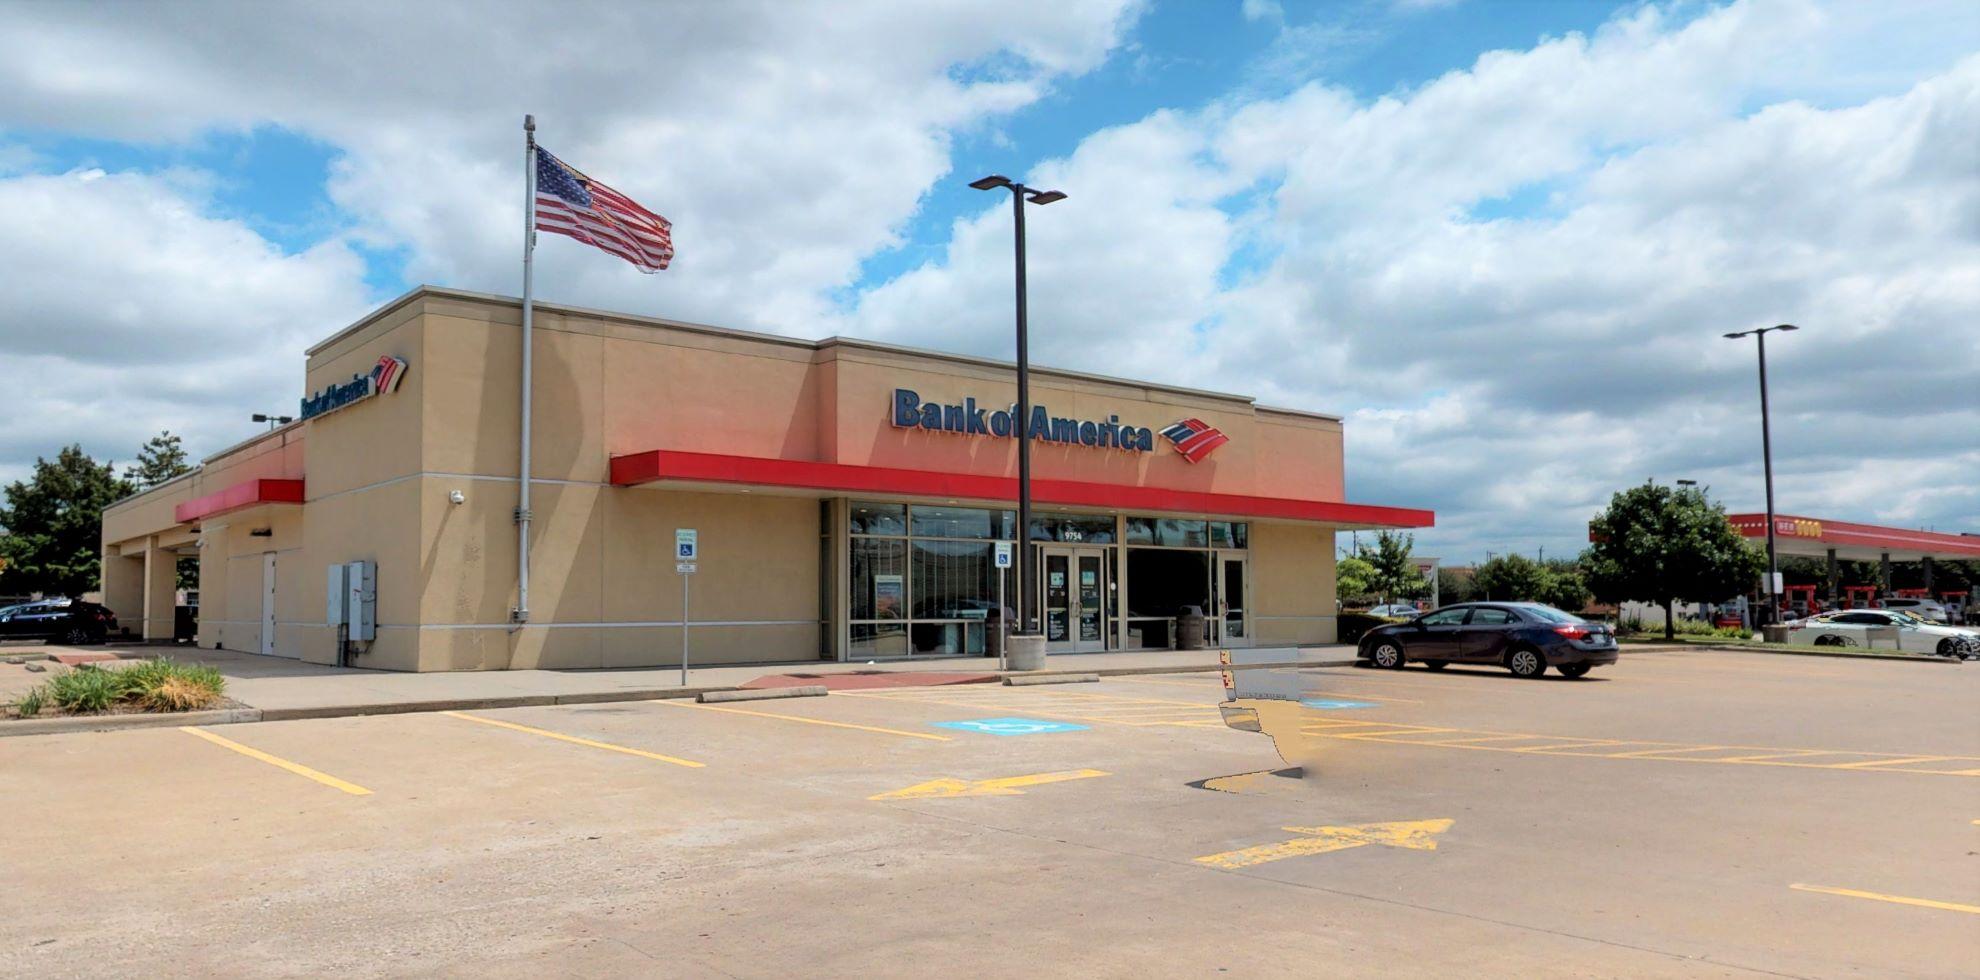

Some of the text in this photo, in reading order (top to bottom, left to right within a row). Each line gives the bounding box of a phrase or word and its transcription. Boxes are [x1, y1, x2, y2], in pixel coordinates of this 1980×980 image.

[892, 388, 987, 436] Bank
[1028, 405, 1153, 452] America
[1064, 531, 1083, 541] 9754
